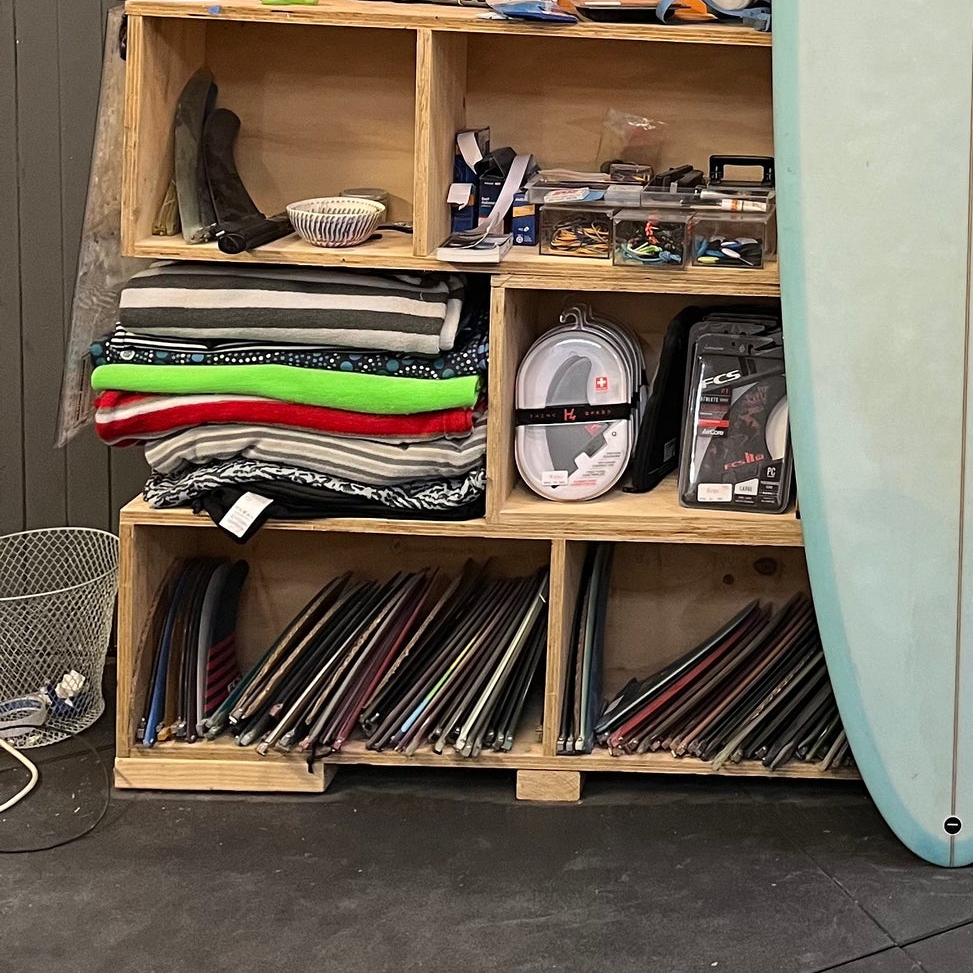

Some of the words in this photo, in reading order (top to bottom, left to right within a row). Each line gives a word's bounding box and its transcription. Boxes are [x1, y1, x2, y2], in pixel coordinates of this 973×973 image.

[701, 369, 742, 389] FCS
[701, 428, 725, 436] AirCore
[766, 467, 777, 477] PC
